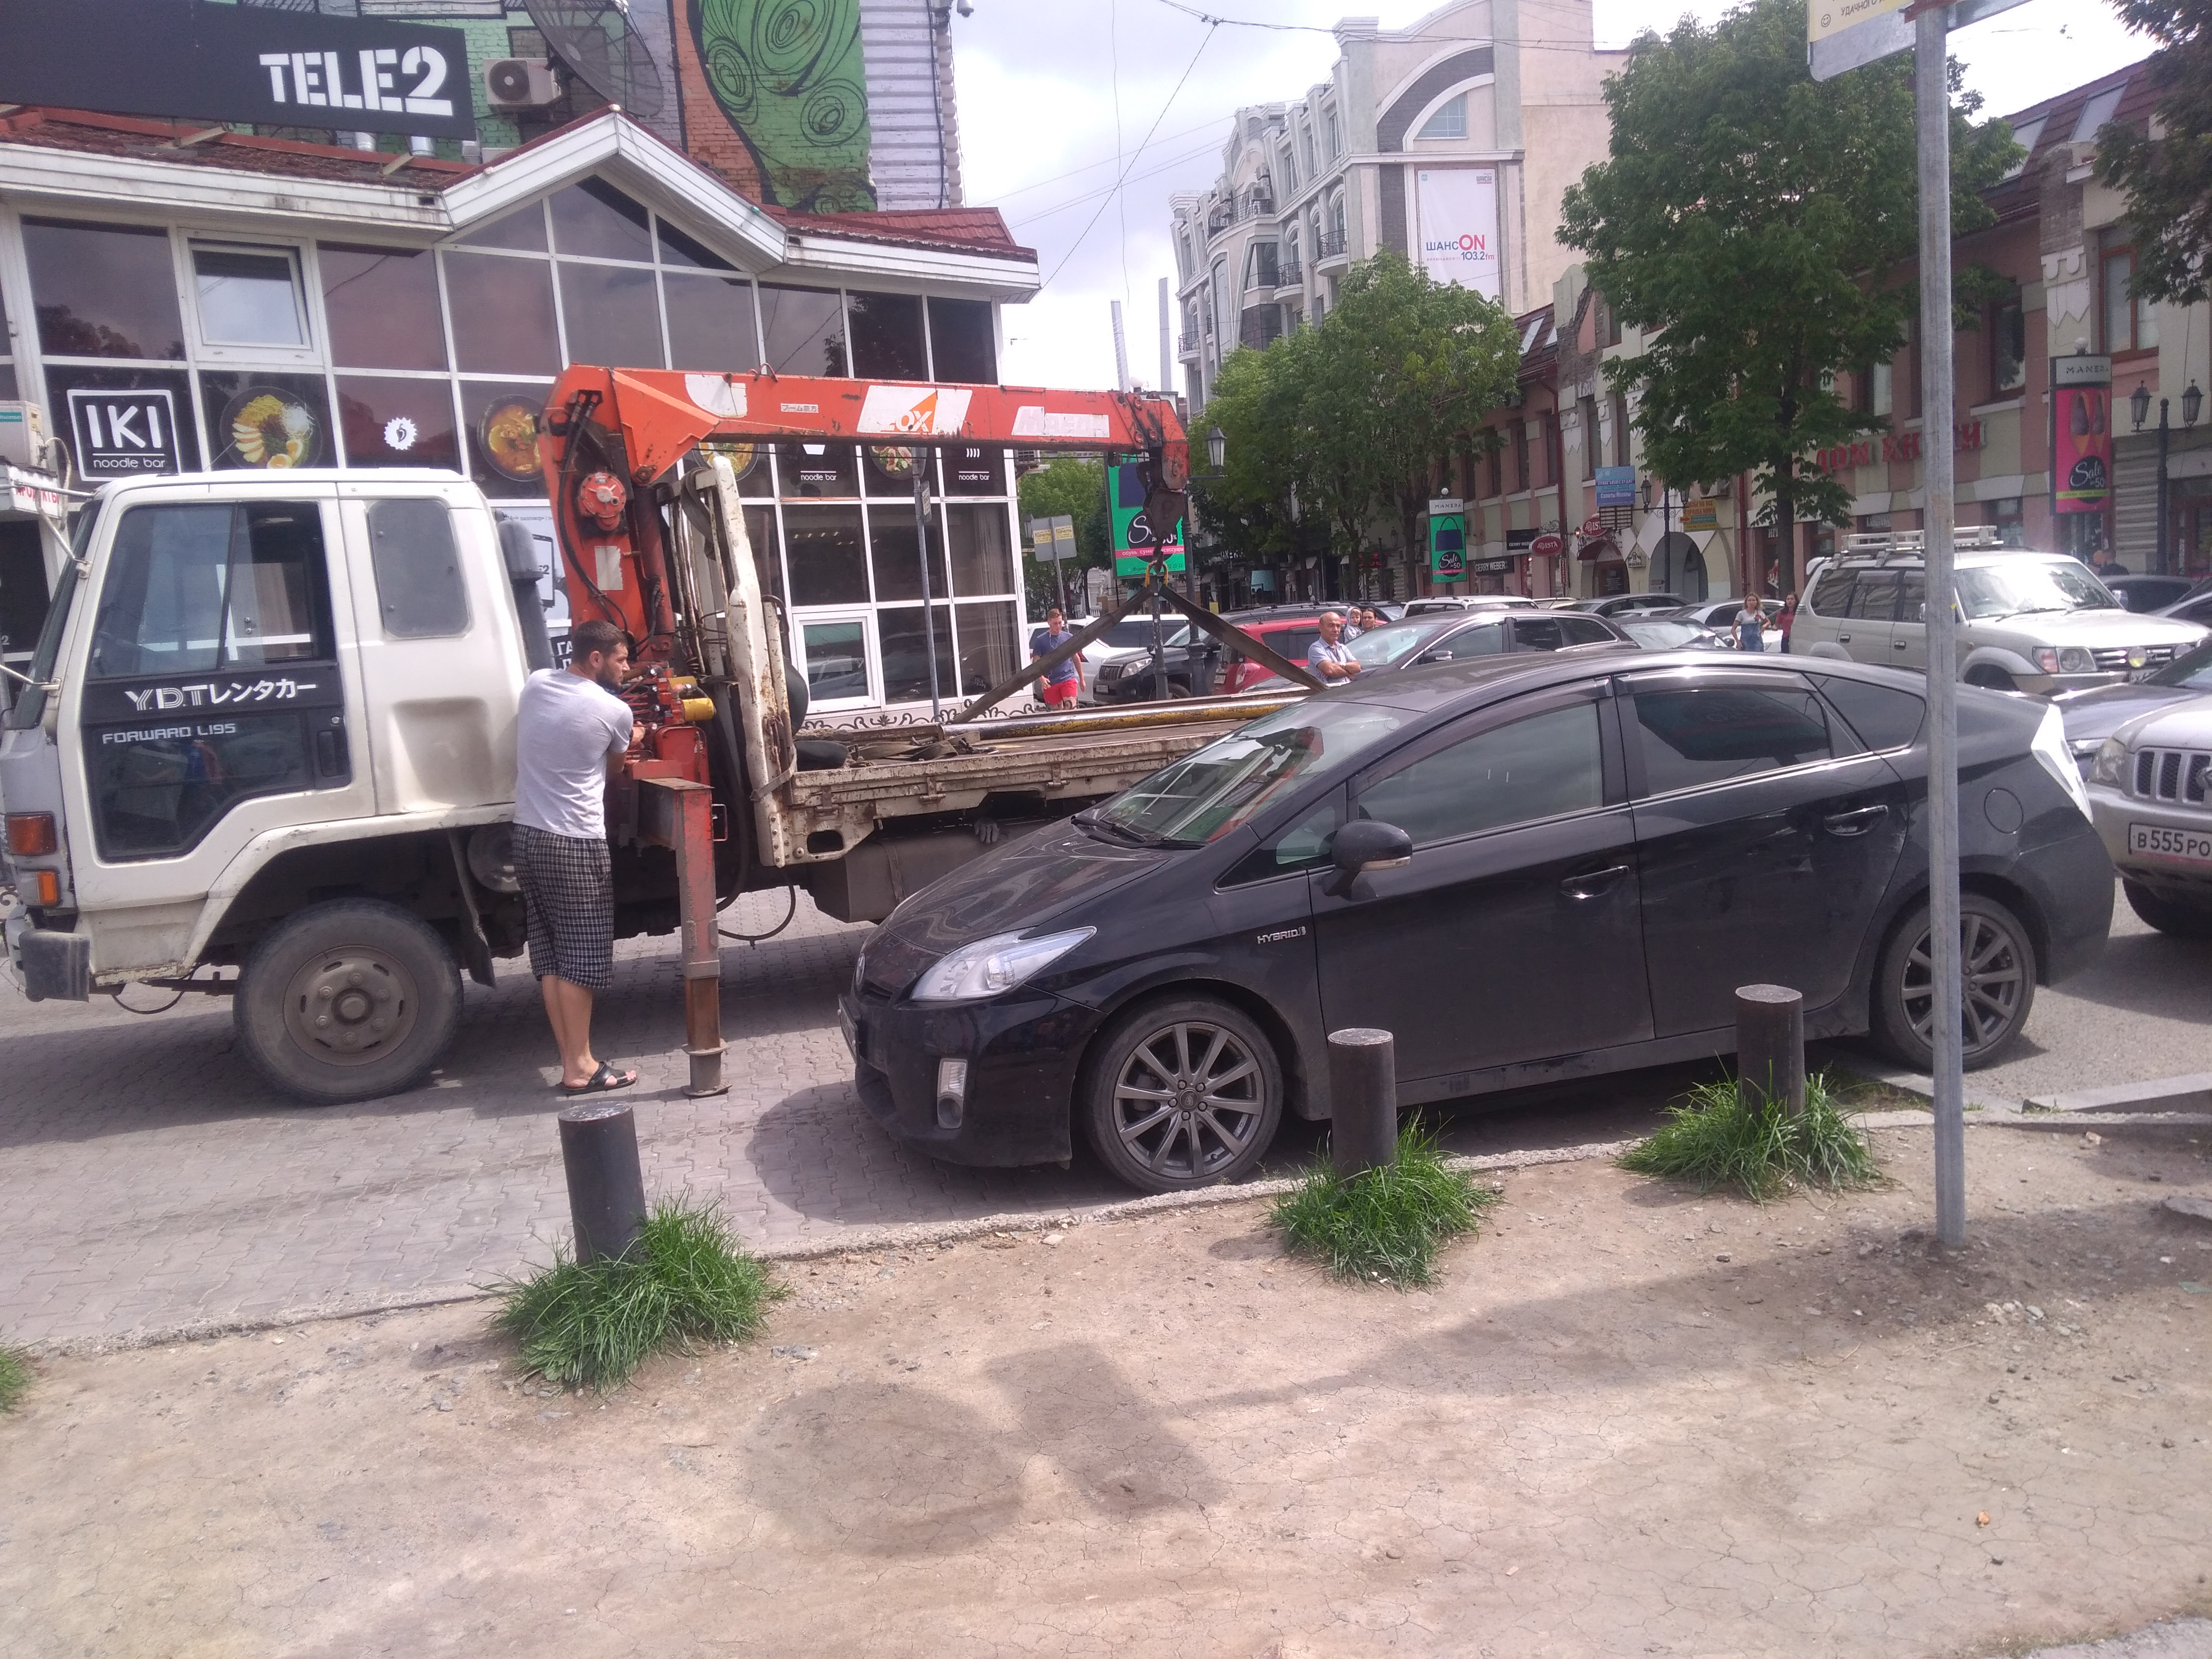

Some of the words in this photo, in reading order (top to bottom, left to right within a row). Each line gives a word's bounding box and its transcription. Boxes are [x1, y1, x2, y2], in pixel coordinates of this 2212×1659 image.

[259, 46, 453, 116] TELE2
[86, 405, 162, 448] IKI
[1882, 422, 1984, 462] КНИ
[94, 458, 138, 468] noodle
[143, 458, 165, 468] bar
[1475, 562, 1489, 572] GERRY
[1489, 560, 1506, 571] WEBER
[102, 726, 191, 744] FORWARD
[1256, 929, 1298, 944] HYBRID
